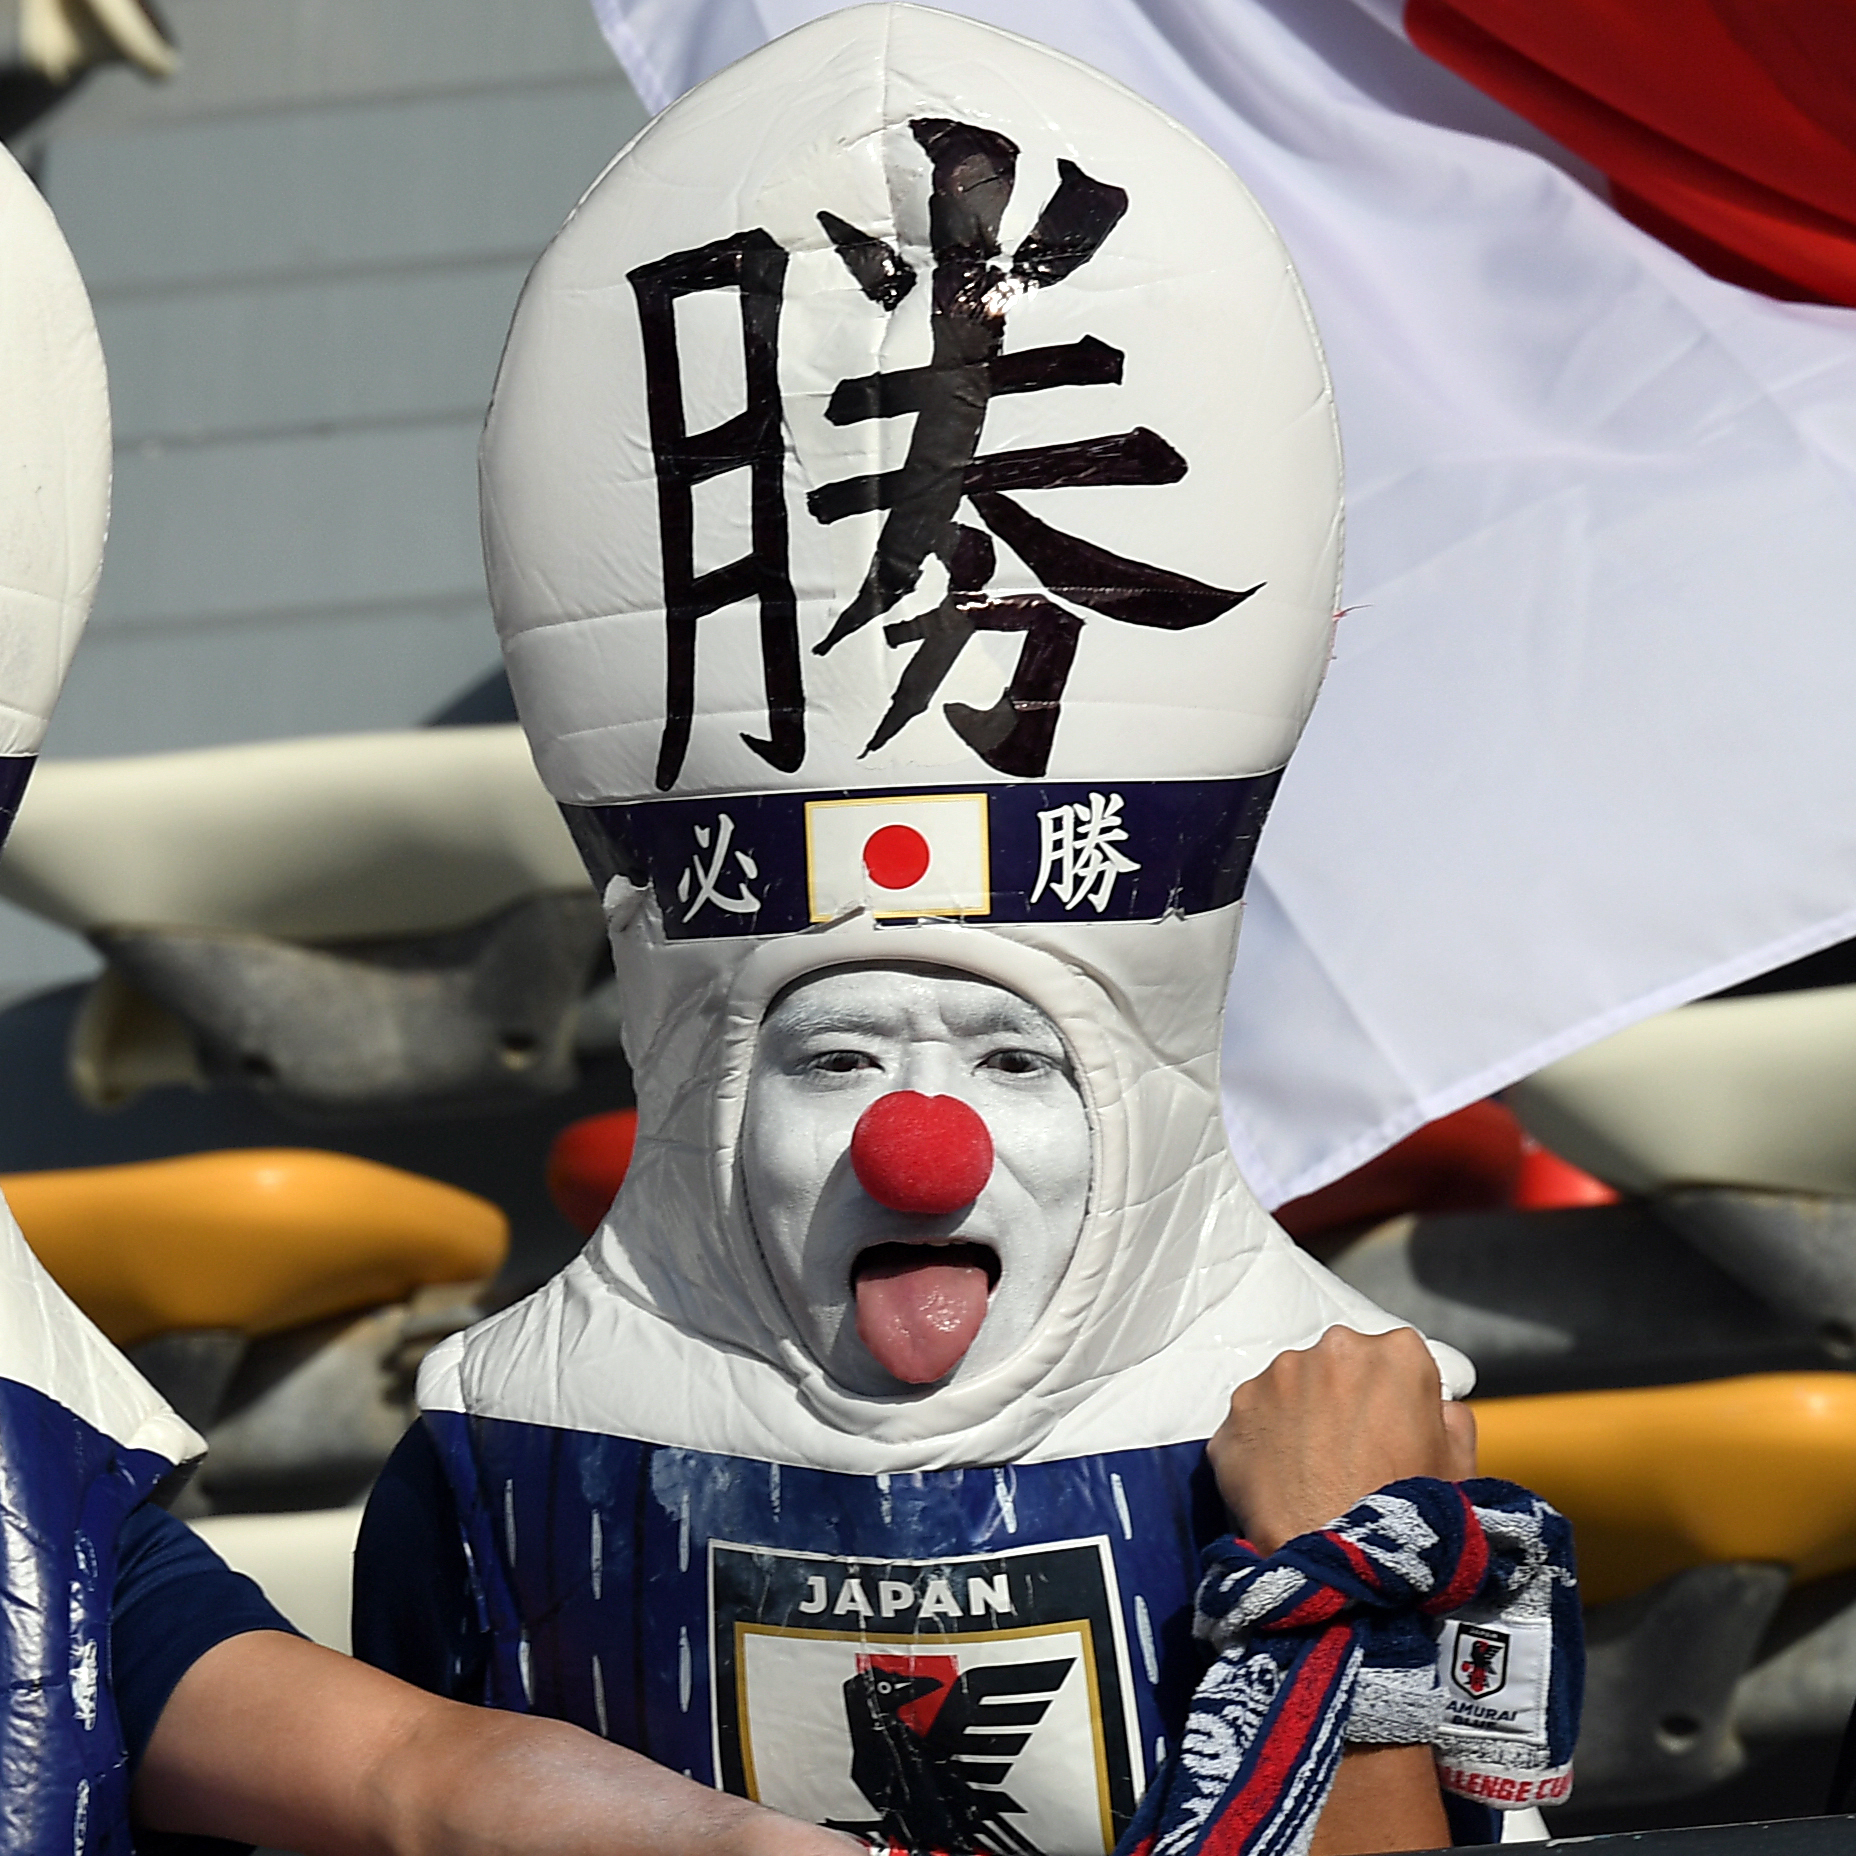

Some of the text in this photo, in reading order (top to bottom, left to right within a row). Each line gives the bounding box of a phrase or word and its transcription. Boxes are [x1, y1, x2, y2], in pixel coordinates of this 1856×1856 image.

[625, 117, 1267, 792] 勝
[676, 791, 1142, 925] 必 勝
[798, 1573, 1014, 1619] JAPAN
[1445, 1699, 1518, 1722] AMURAI
